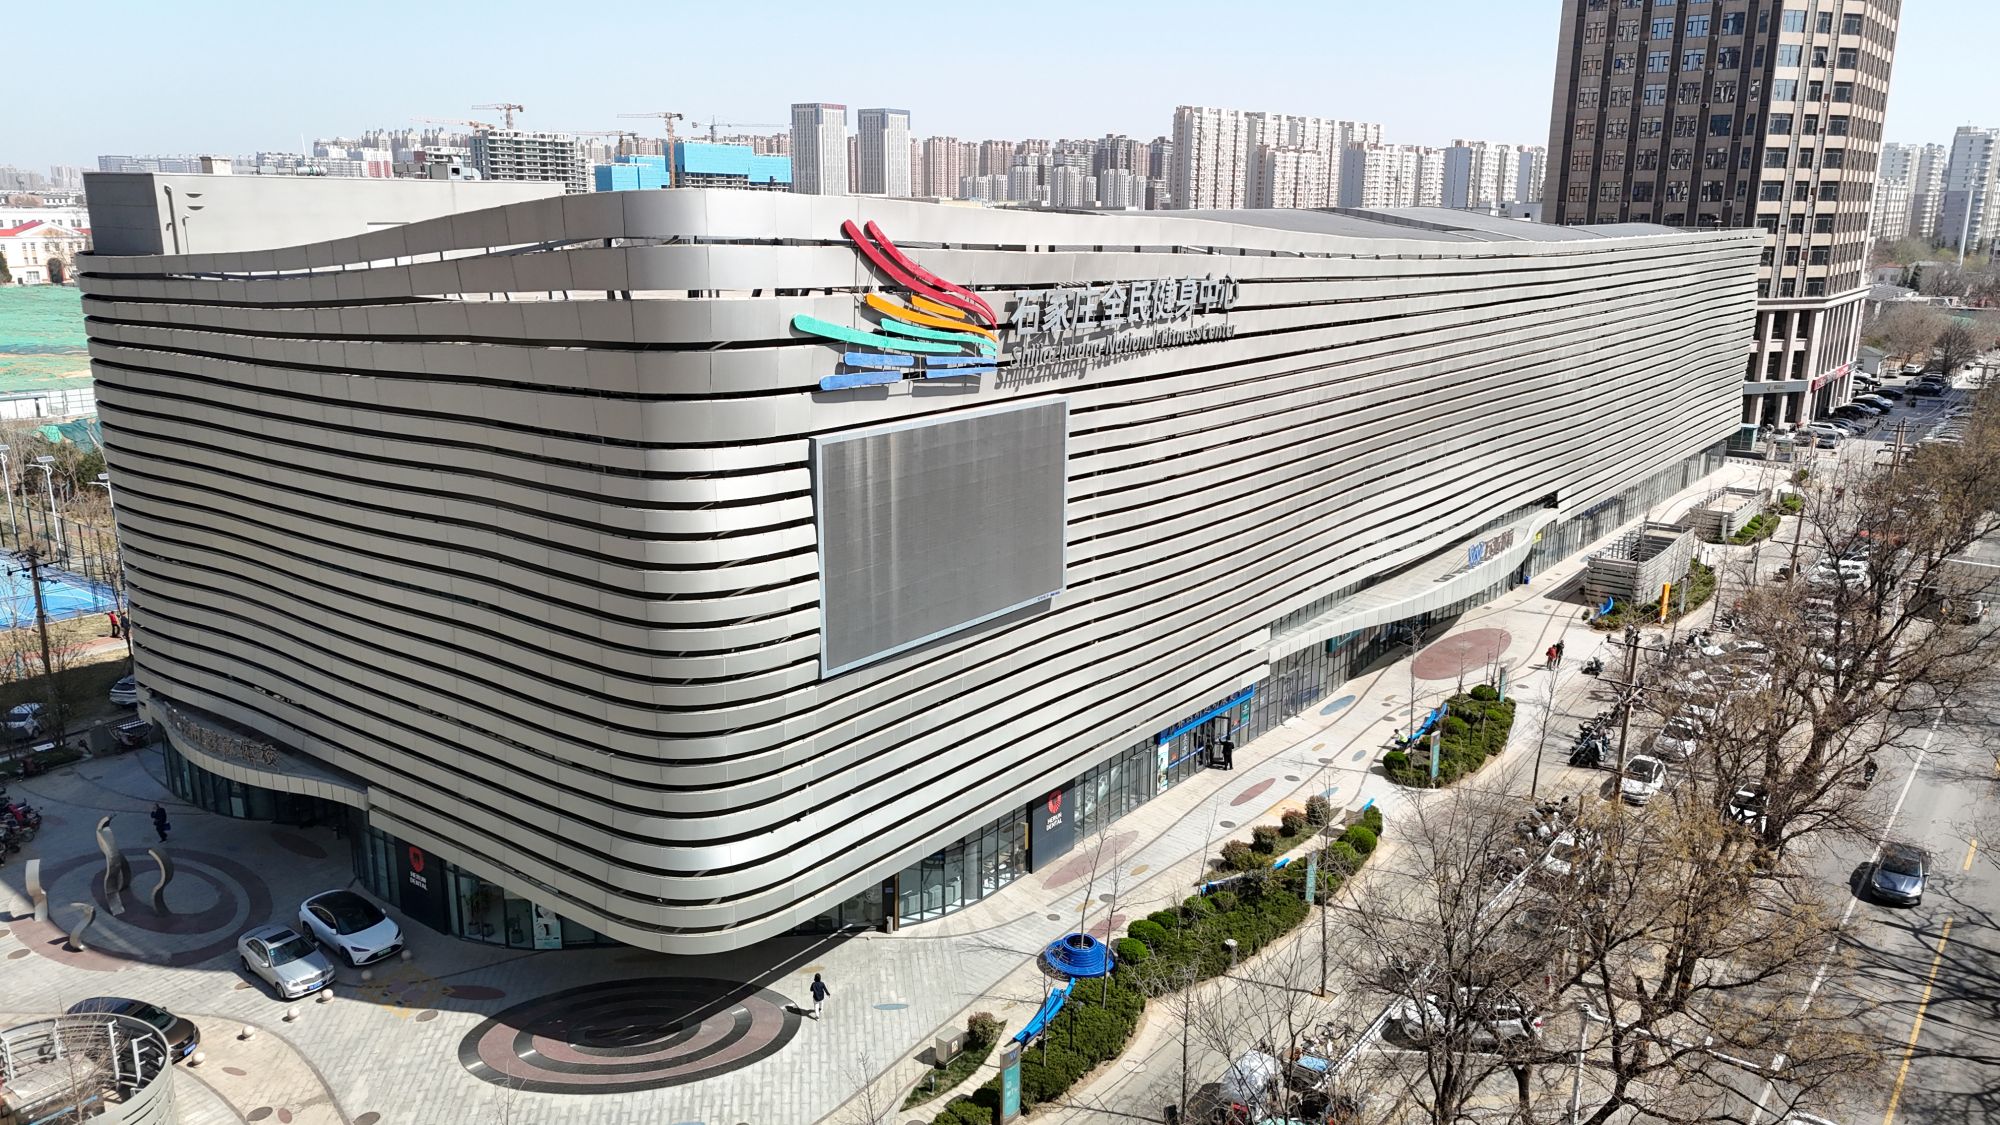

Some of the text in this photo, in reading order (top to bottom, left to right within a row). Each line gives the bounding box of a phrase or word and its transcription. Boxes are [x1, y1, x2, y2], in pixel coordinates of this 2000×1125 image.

[1011, 273, 1240, 335] 石家庄全民健身中心
[1046, 818, 1062, 831] DENTAL
